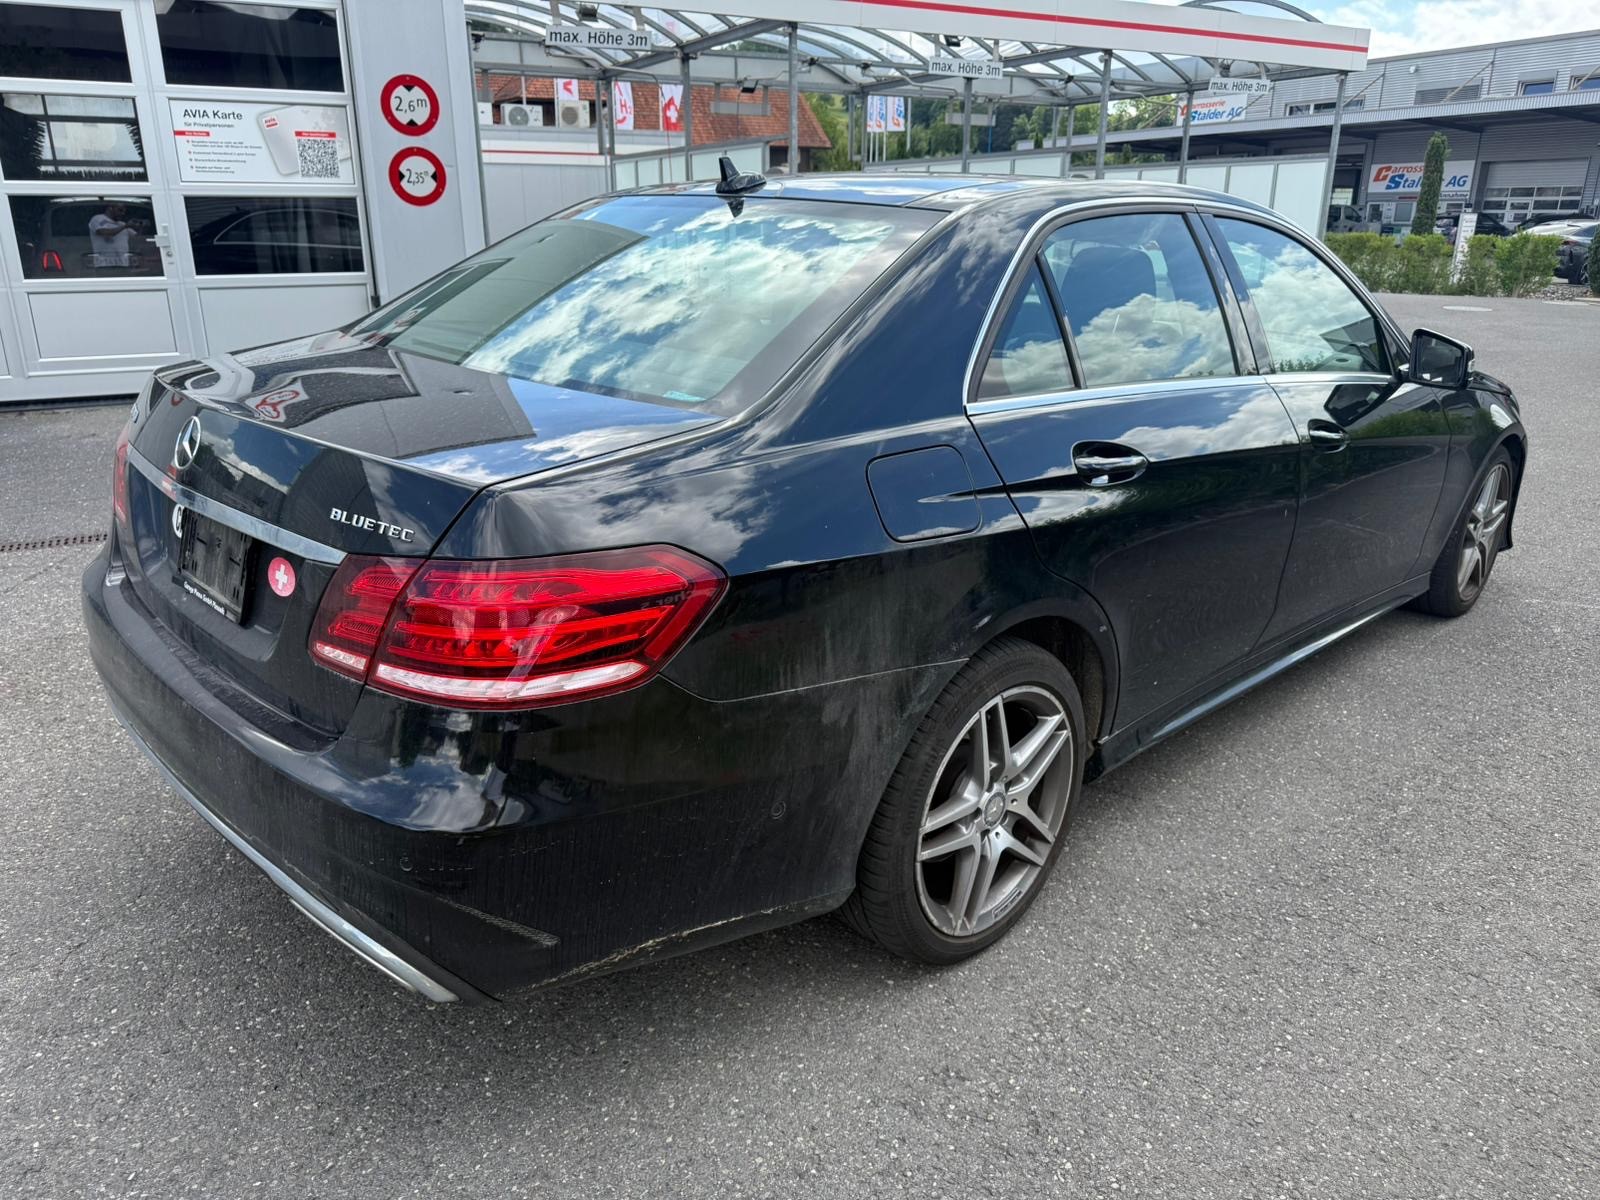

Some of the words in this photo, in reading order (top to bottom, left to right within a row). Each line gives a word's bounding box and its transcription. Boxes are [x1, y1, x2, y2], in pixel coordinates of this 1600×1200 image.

[550, 30, 582, 43] max.
[588, 30, 623, 45] Höhe
[627, 33, 648, 46] 3m
[931, 61, 955, 72] max.
[958, 62, 983, 75] Höhe
[985, 64, 1000, 76] 3m
[1210, 81, 1230, 90] max.
[1231, 81, 1253, 92] Höhe
[1254, 82, 1267, 92] 3m
[183, 108, 210, 119] AVIA
[212, 109, 243, 121] Karte
[1226, 106, 1243, 119] AG
[1373, 165, 1424, 182] Carross
[1385, 174, 1422, 190] Stal
[1445, 175, 1468, 187] AG
[330, 507, 415, 542] BLUETEC
